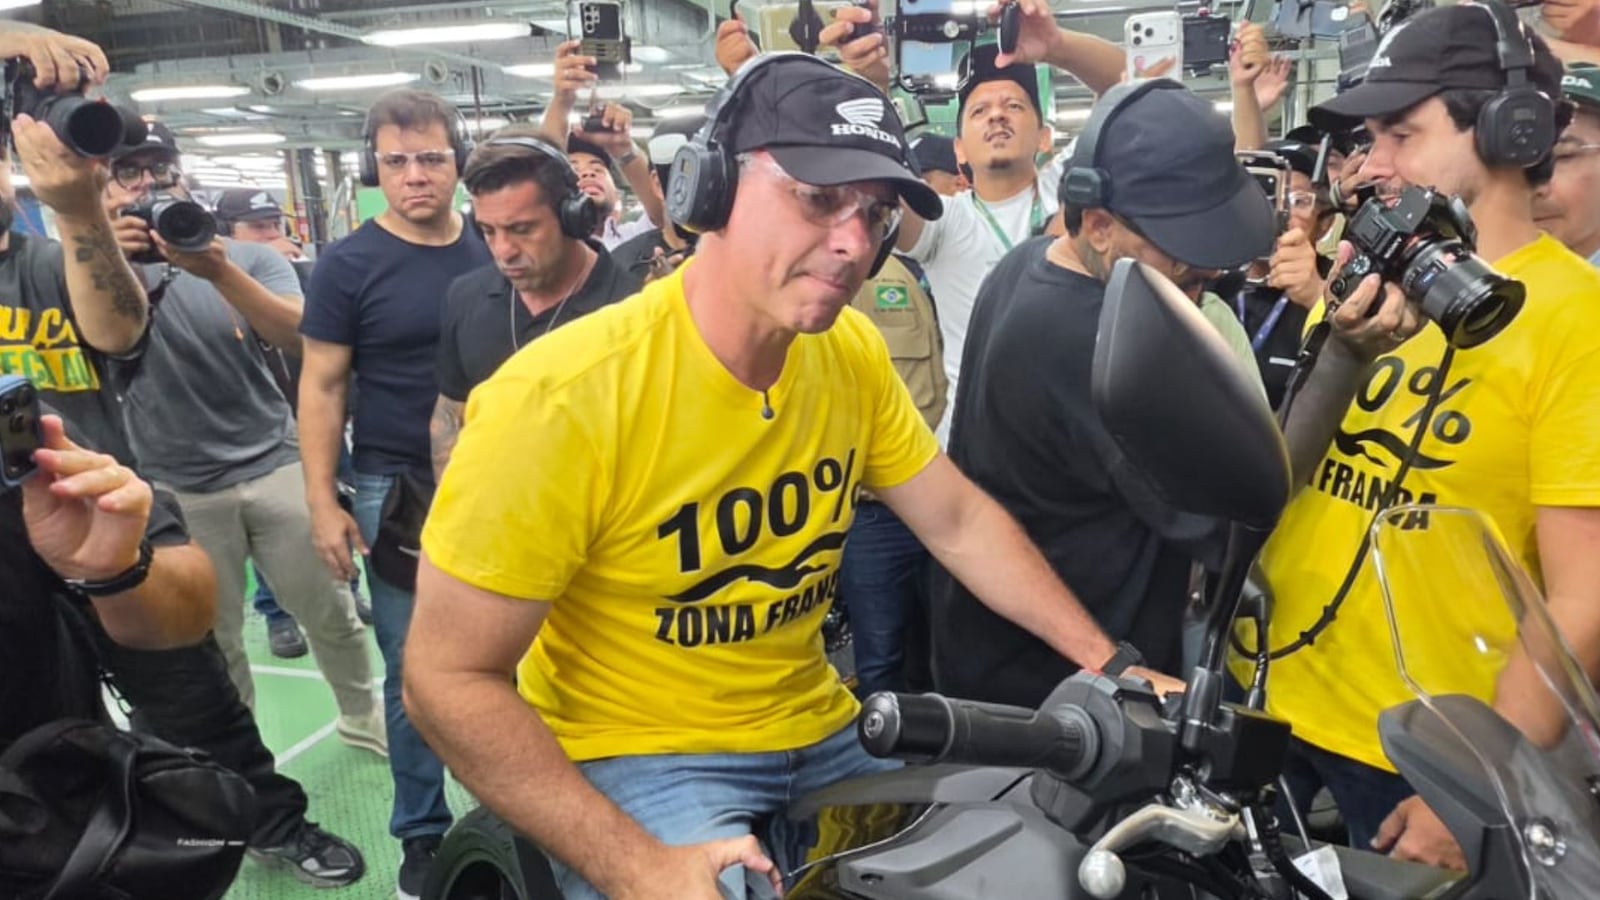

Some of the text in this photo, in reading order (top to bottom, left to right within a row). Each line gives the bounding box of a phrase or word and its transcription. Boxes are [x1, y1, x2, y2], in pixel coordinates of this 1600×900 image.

[830, 123, 902, 148] HONDA
[1356, 356, 1472, 444] 0%
[657, 448, 861, 573] 100%
[655, 605, 755, 648] ZONA
